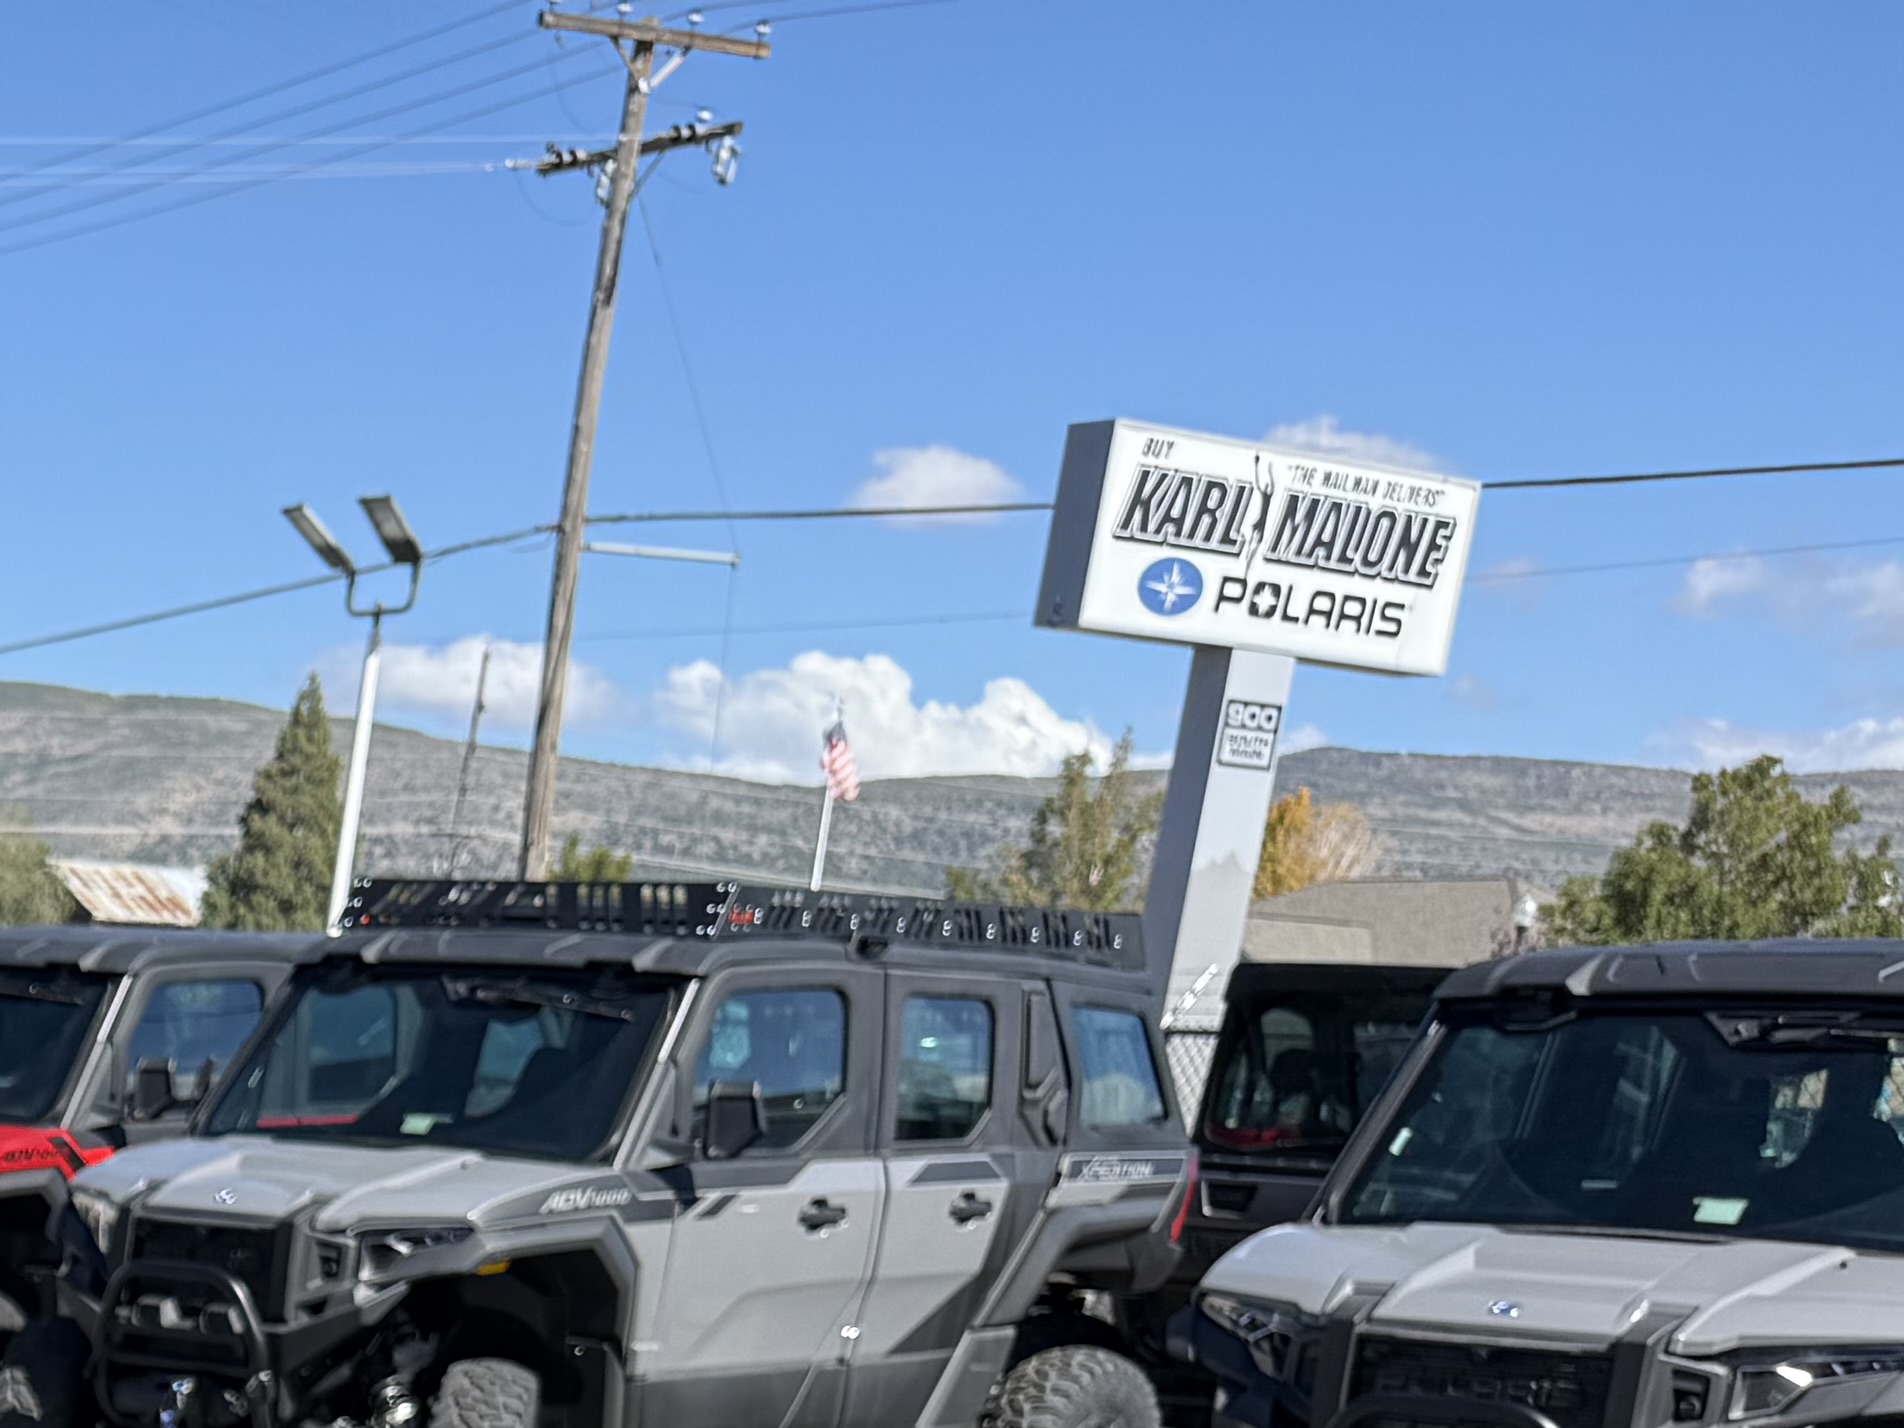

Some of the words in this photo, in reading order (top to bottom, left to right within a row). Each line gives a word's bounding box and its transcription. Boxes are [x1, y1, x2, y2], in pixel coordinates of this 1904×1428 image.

[1142, 438, 1175, 459] BUY
[1113, 461, 1255, 557] KARL
[1263, 488, 1457, 590] MALONE
[1213, 575, 1407, 638] POLARIS
